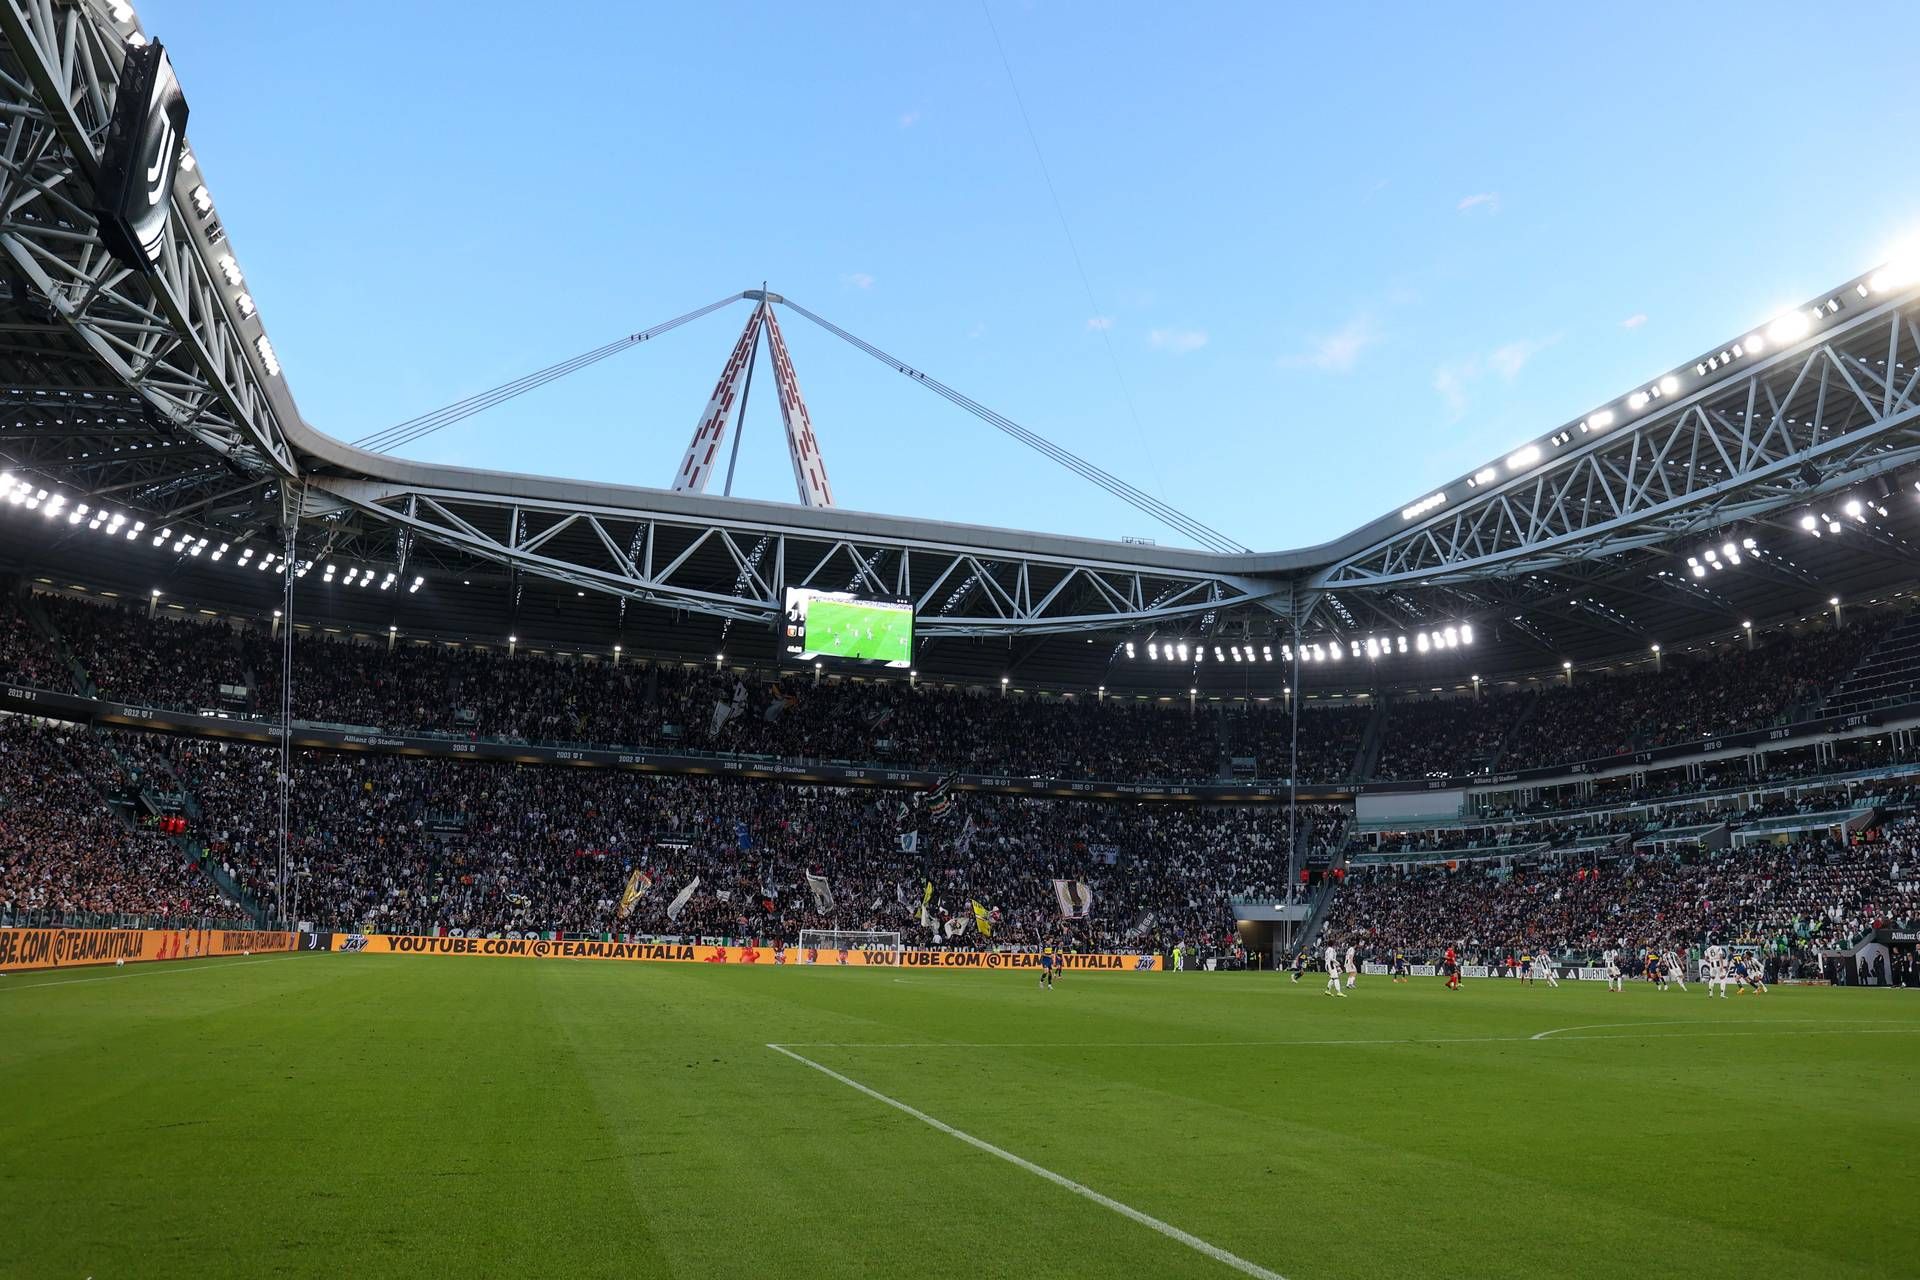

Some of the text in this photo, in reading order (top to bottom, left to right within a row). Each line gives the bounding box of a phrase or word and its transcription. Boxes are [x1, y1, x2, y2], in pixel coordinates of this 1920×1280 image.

[344, 735, 404, 746] Allianz Stadium
[753, 763, 806, 774] Allianz Stadium
[1473, 774, 1518, 785] Allianz Stadium
[1116, 785, 1135, 793] Allianz
[1891, 932, 1915, 940] Allianz
[340, 939, 369, 952] JAY
[387, 937, 695, 960] YOUTUBE.COM/@TEAMJAYITALIA
[863, 951, 1123, 969] YOUTUBE.COM/@TEAMYITALIA
[1135, 959, 1155, 970] JAY
[1462, 967, 1487, 976] JUVENTUS
[1581, 968, 1609, 979] JUVENTU
